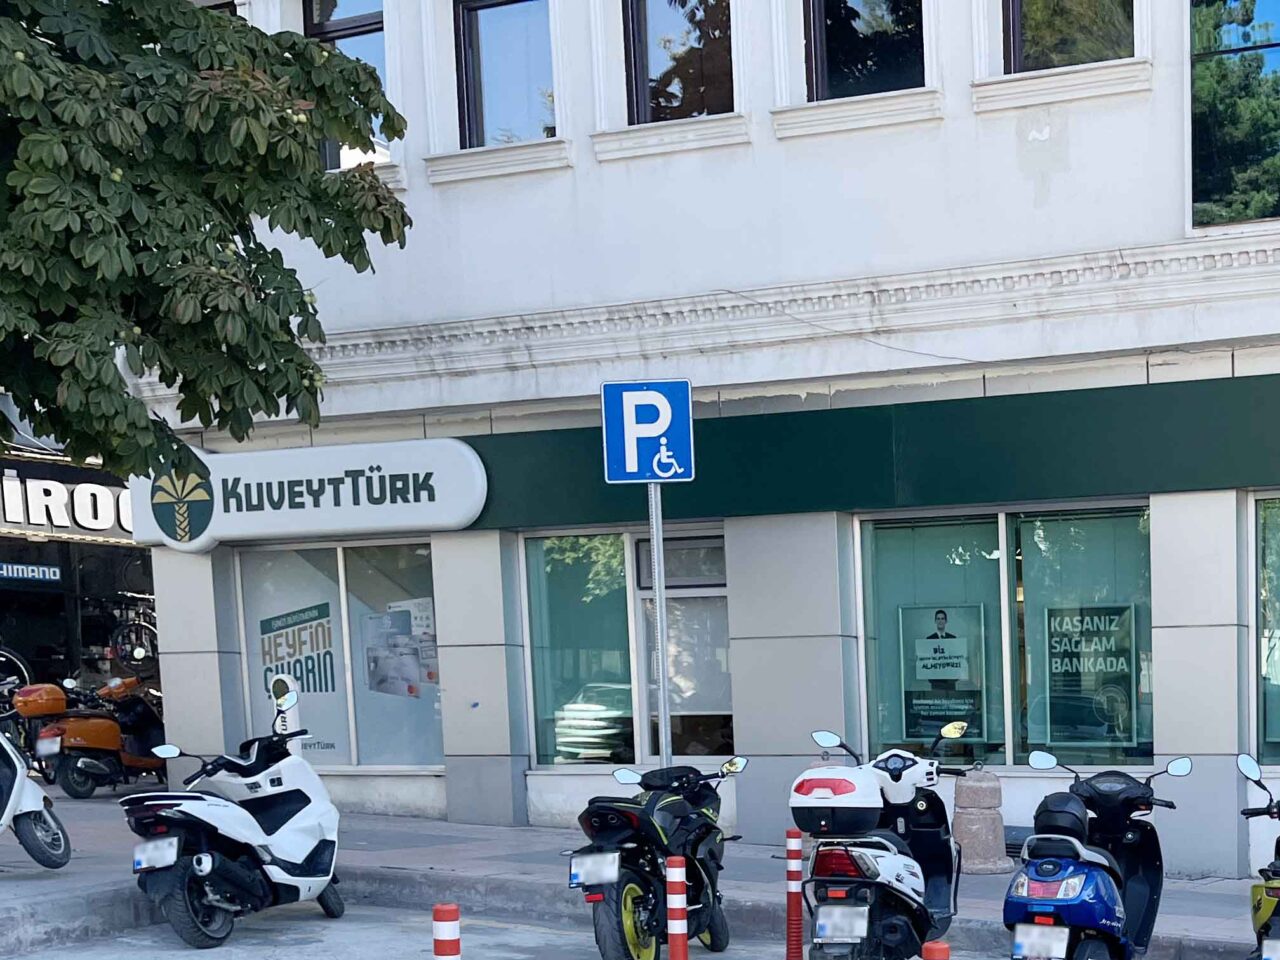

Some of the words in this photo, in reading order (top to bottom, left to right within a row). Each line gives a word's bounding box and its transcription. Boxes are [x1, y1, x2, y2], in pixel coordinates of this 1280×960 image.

[623, 391, 671, 472] P
[221, 465, 435, 513] KUVEYTTÜRK
[0, 564, 60, 580] HIMANO
[1050, 616, 1120, 632] KASANIZ
[261, 619, 332, 666] KEYFİNİ
[1051, 633, 1115, 653] SAĞLAM
[1052, 657, 1129, 673] BANKADA
